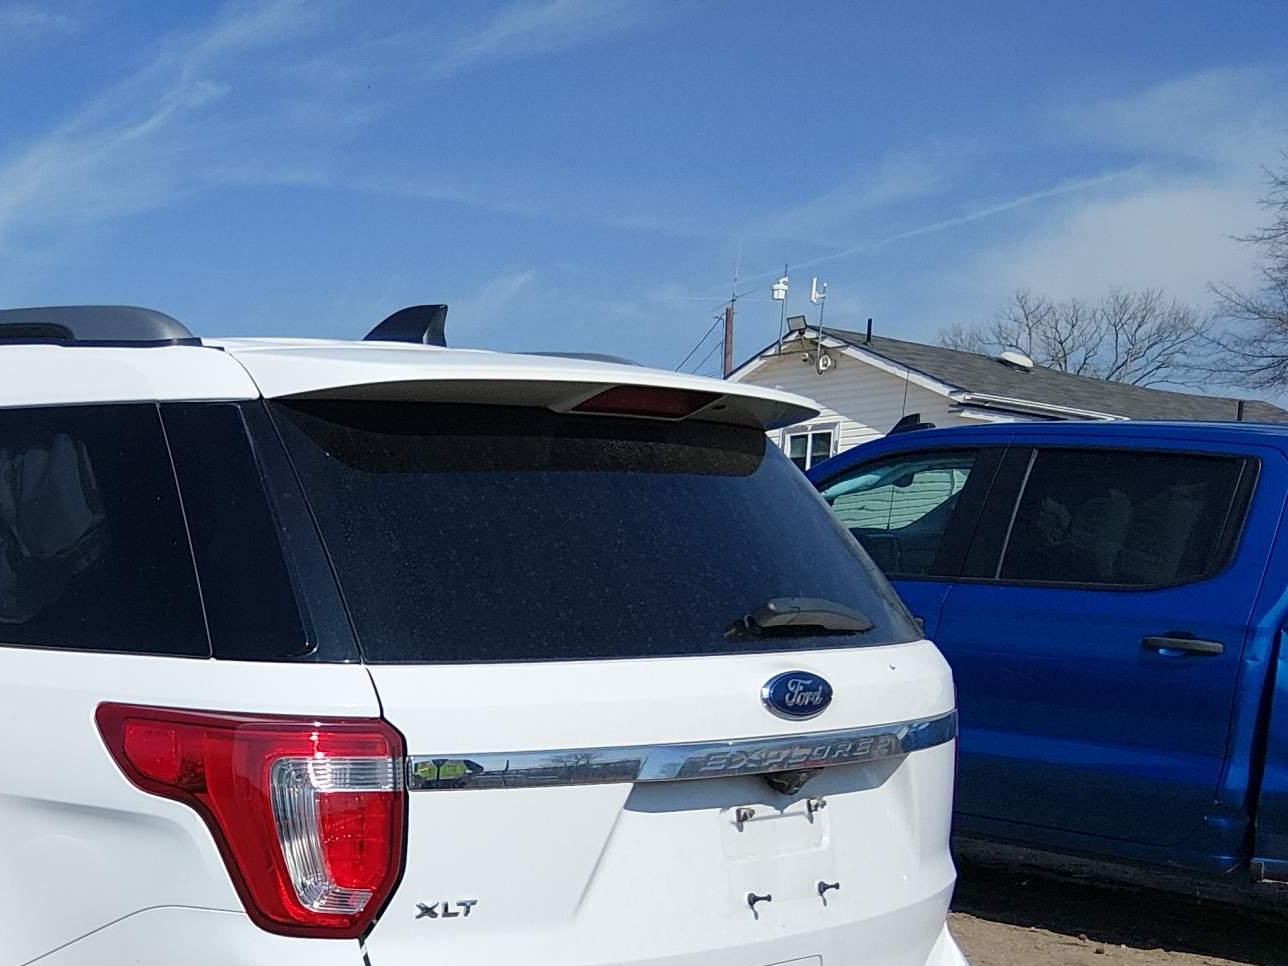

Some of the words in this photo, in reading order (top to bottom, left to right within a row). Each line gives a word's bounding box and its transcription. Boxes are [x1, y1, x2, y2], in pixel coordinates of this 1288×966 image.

[784, 678, 823, 707] Ford
[699, 734, 896, 771] EXPLORER
[415, 899, 478, 919] XLT
